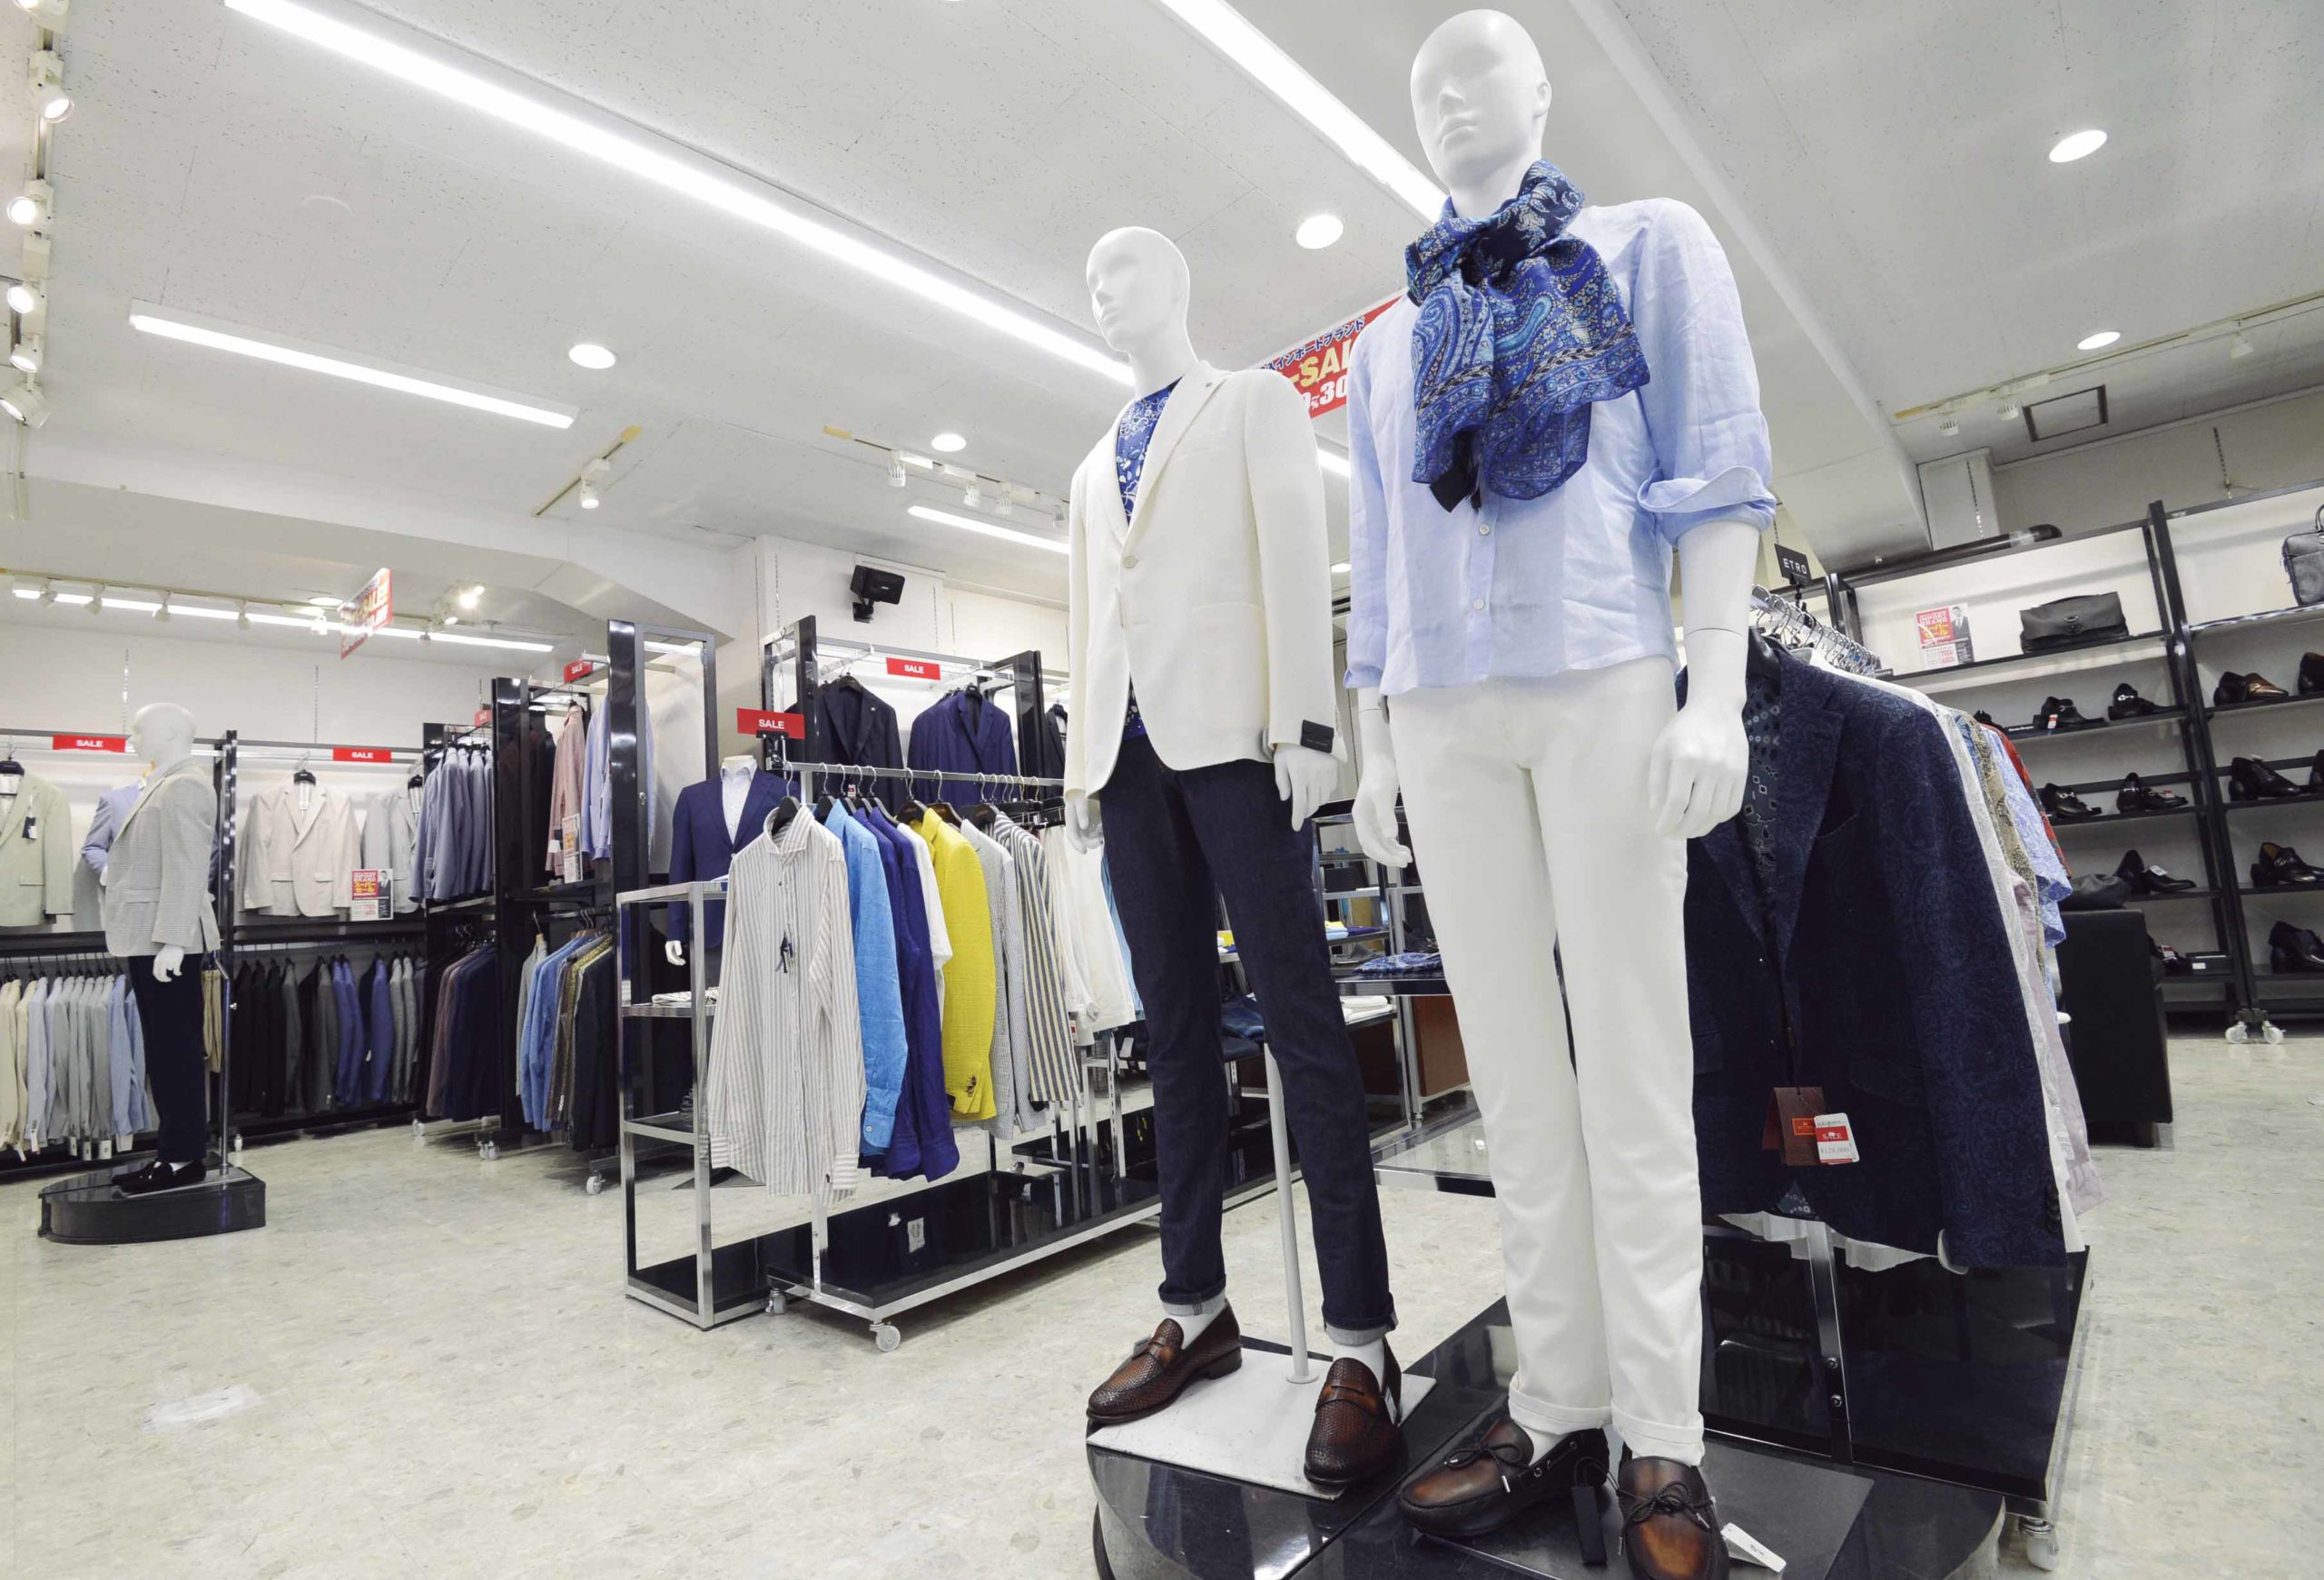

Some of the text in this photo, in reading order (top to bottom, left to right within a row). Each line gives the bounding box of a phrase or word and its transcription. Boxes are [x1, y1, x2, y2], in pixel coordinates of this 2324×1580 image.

[1783, 558, 1807, 574] ETRO
[904, 665, 924, 674] SALE
[758, 718, 784, 729] SALE
[76, 739, 103, 747] SALE
